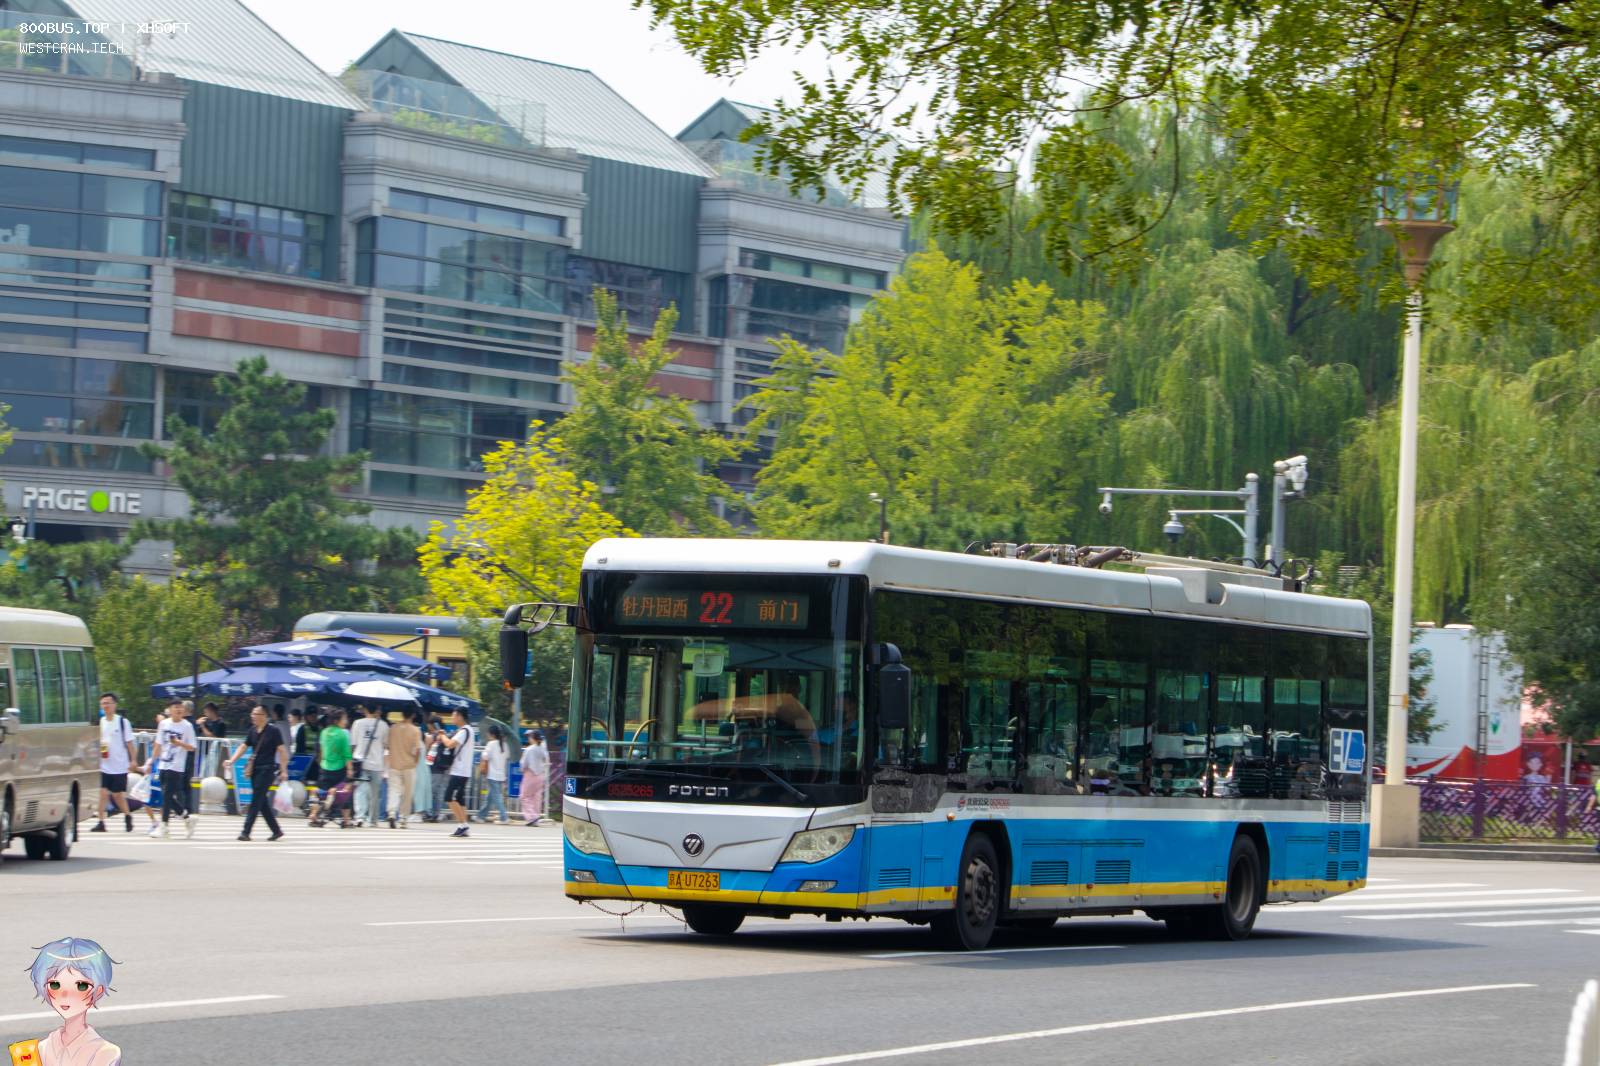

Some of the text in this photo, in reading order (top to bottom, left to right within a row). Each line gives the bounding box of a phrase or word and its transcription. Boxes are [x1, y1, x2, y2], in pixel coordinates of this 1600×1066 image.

[623, 591, 799, 624] 牡丹园西 22 前门
[669, 784, 729, 797] FOTON
